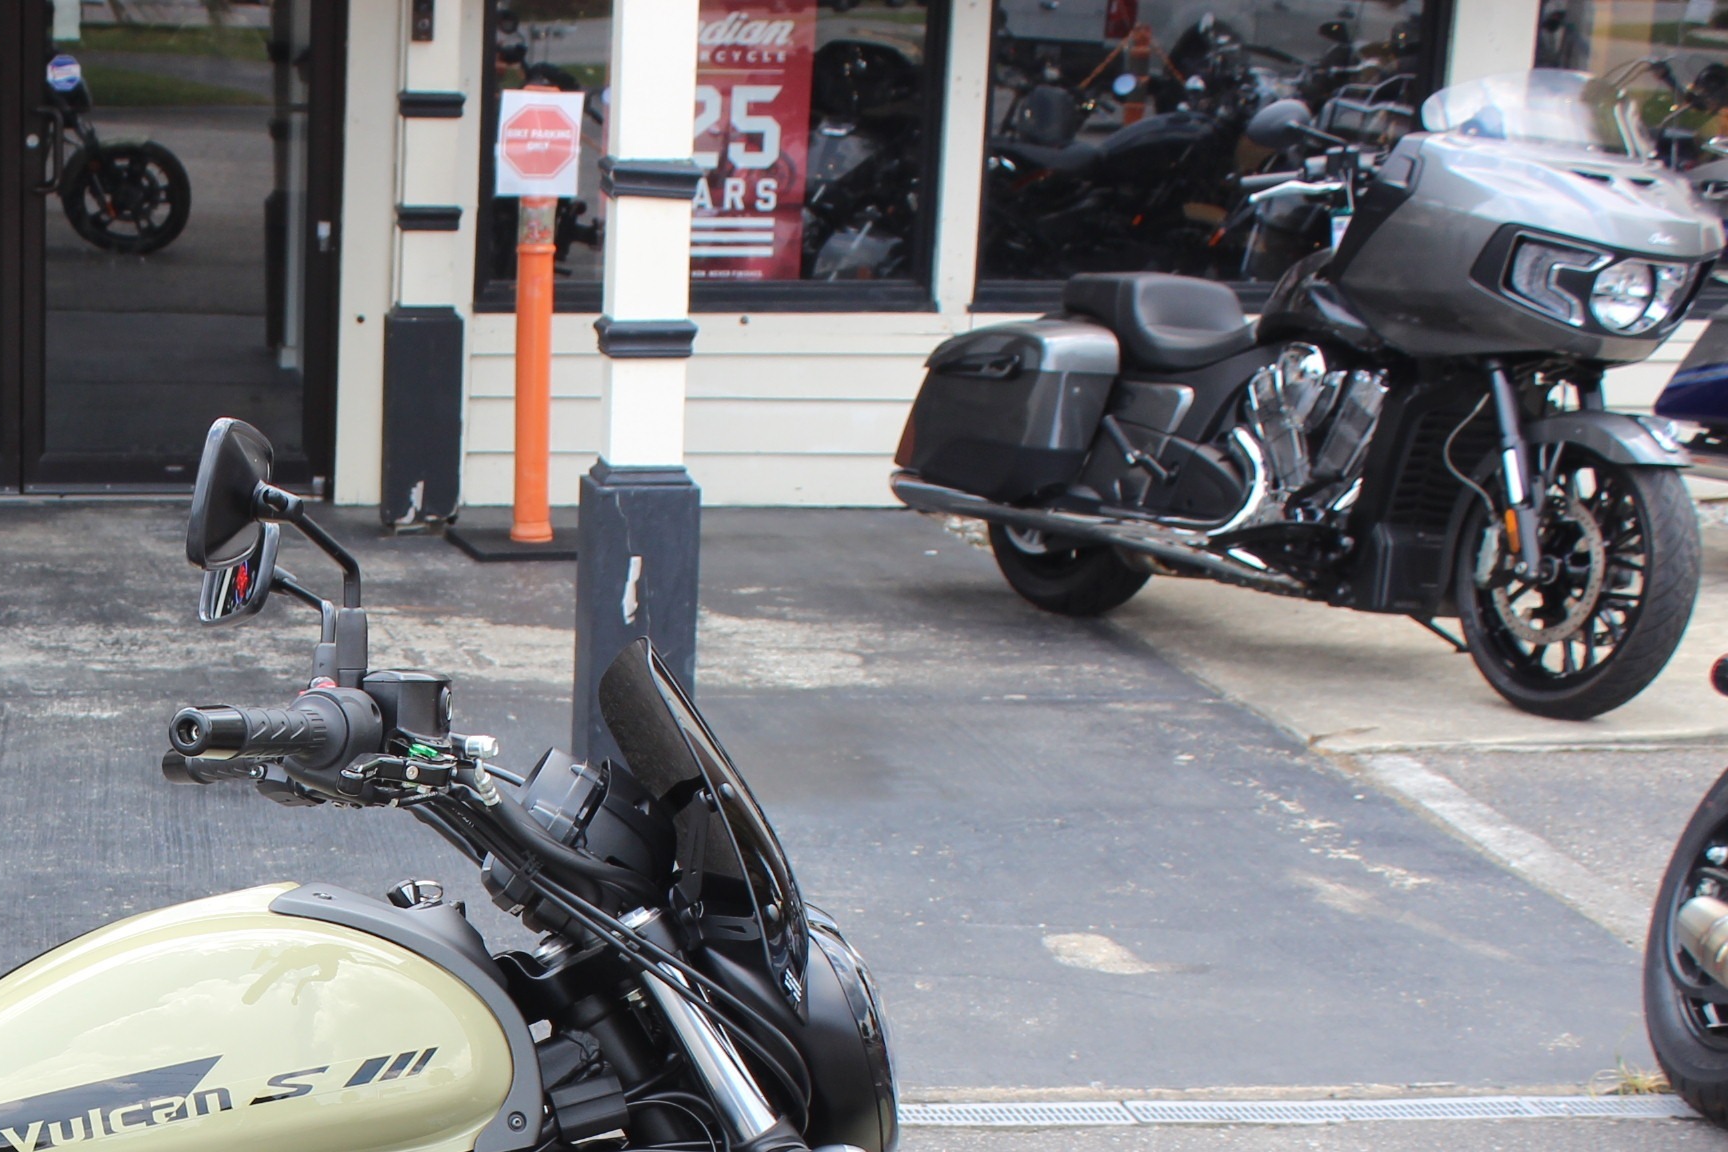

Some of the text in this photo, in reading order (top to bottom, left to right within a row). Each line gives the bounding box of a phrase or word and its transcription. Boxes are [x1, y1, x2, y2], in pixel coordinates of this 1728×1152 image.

[699, 11, 795, 47] dian
[699, 50, 787, 64] RCYCLE
[506, 128, 572, 140] BIKE PARKING
[526, 141, 550, 151] ONLY
[692, 177, 778, 213] ARS
[248, 1064, 330, 1107] S
